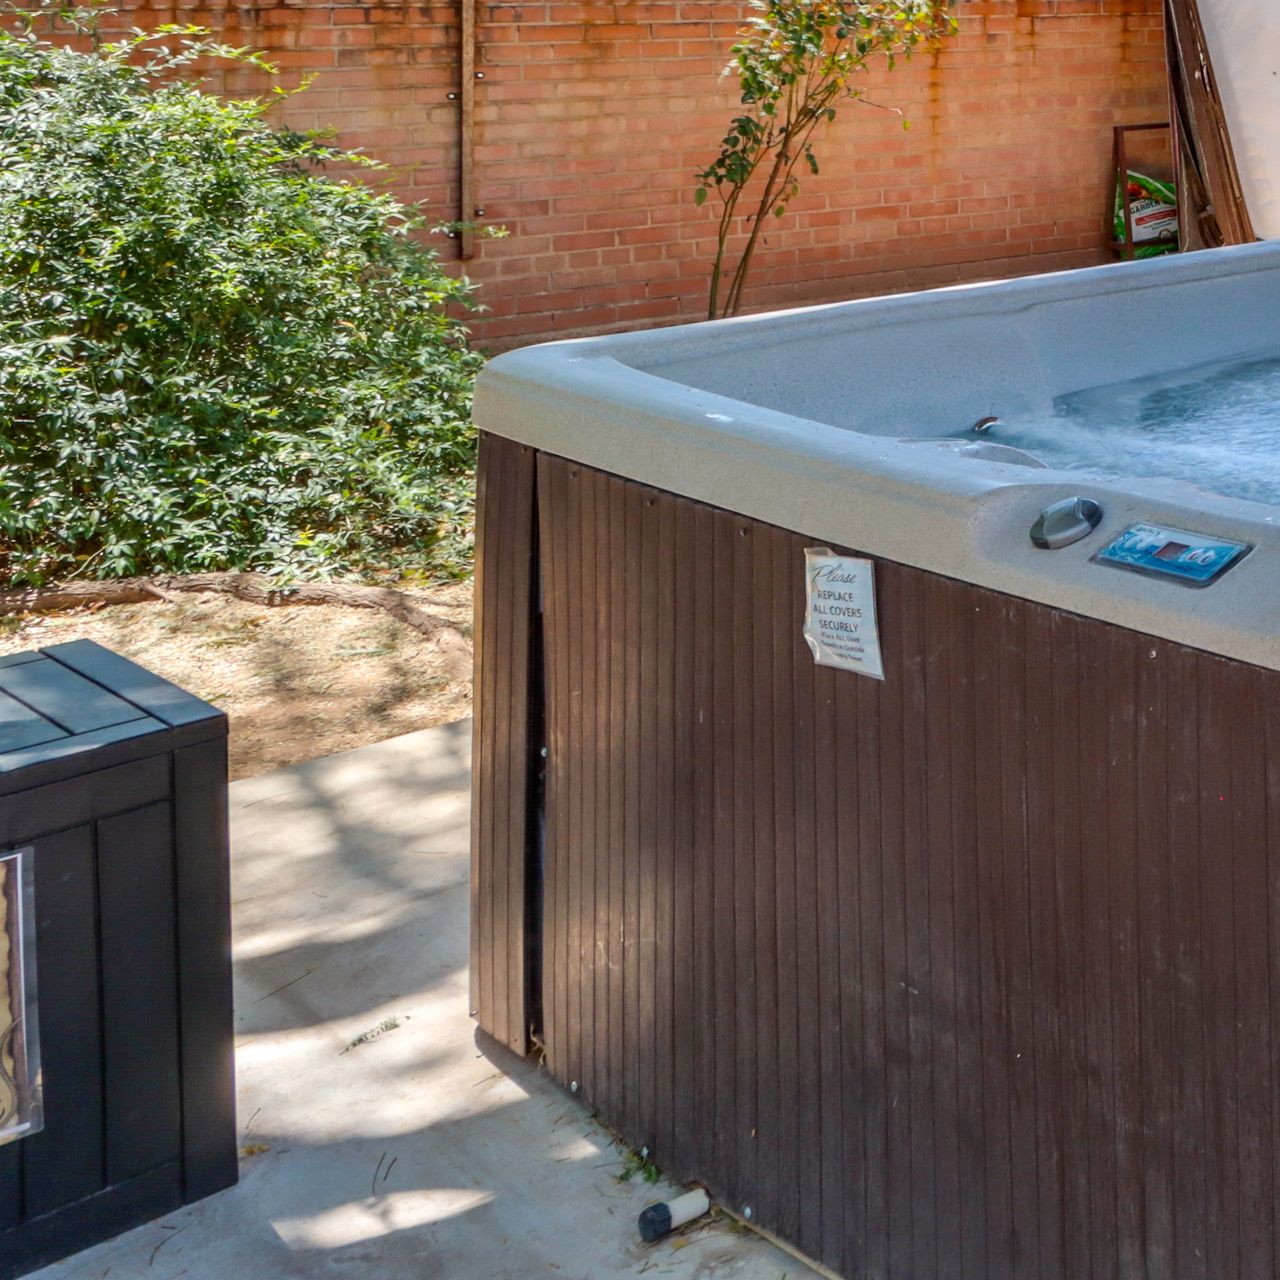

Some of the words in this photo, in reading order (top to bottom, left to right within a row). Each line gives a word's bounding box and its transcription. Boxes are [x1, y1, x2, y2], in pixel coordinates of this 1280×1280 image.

[811, 563, 857, 584] Please
[818, 590, 854, 602] REPLACE
[813, 604, 828, 615] ALL
[829, 606, 862, 618] COVERS
[819, 620, 859, 632] SECURELY
